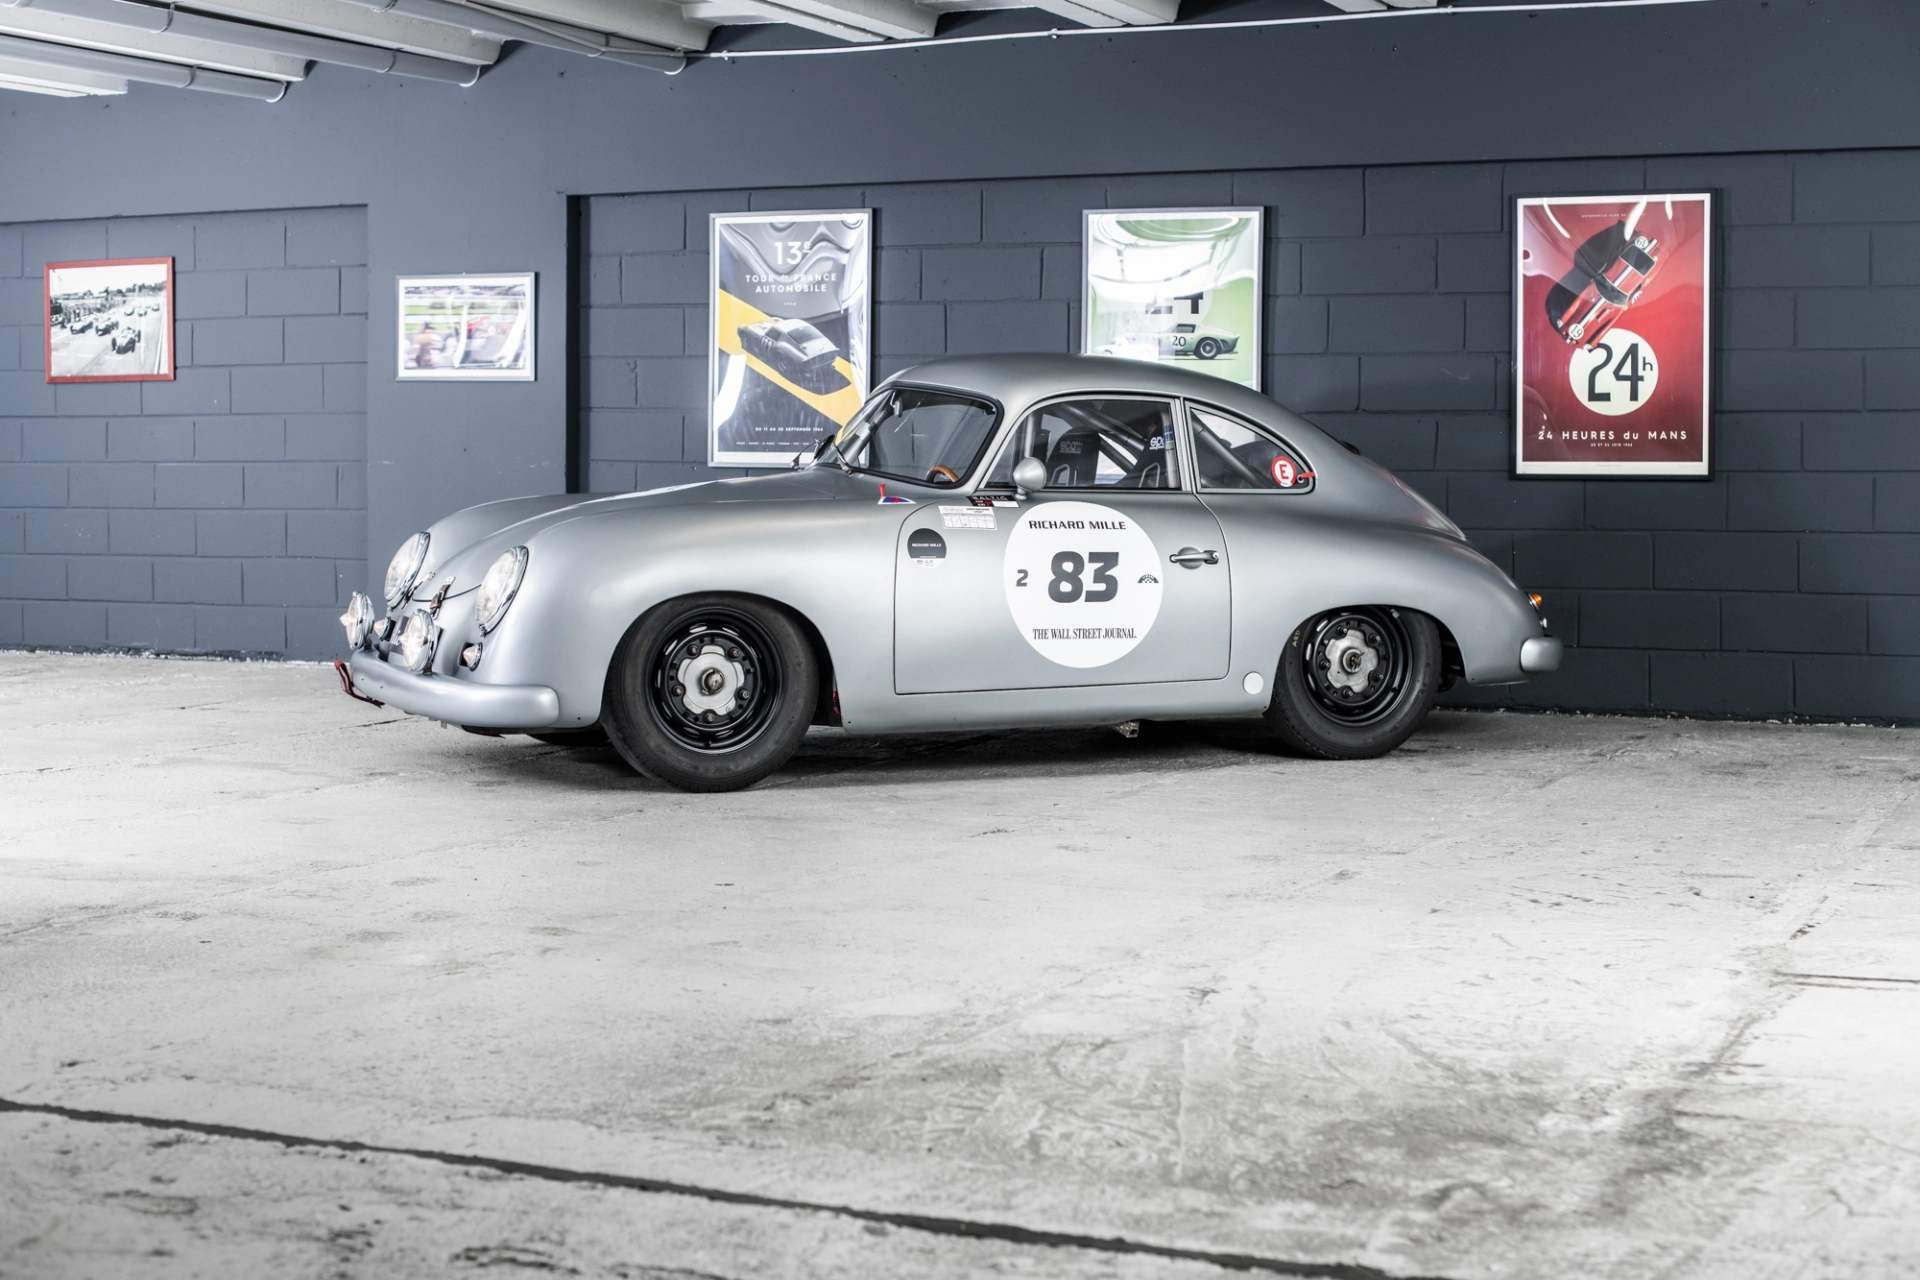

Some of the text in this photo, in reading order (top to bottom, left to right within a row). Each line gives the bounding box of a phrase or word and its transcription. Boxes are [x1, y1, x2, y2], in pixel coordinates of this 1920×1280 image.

[745, 274, 775, 283] TOUR
[793, 273, 837, 282] FRANCE
[755, 284, 827, 293] AUTOMOBILE
[1172, 335, 1187, 347] 20
[1538, 431, 1687, 440] 24 HEURES du MANS
[1279, 464, 1289, 480] E
[1028, 520, 1127, 530] RICHARD MILLE
[1015, 550, 1120, 604] 2 83
[1033, 629, 1049, 640] THE
[1051, 629, 1072, 640] WALL
[1073, 628, 1102, 640] STREET
